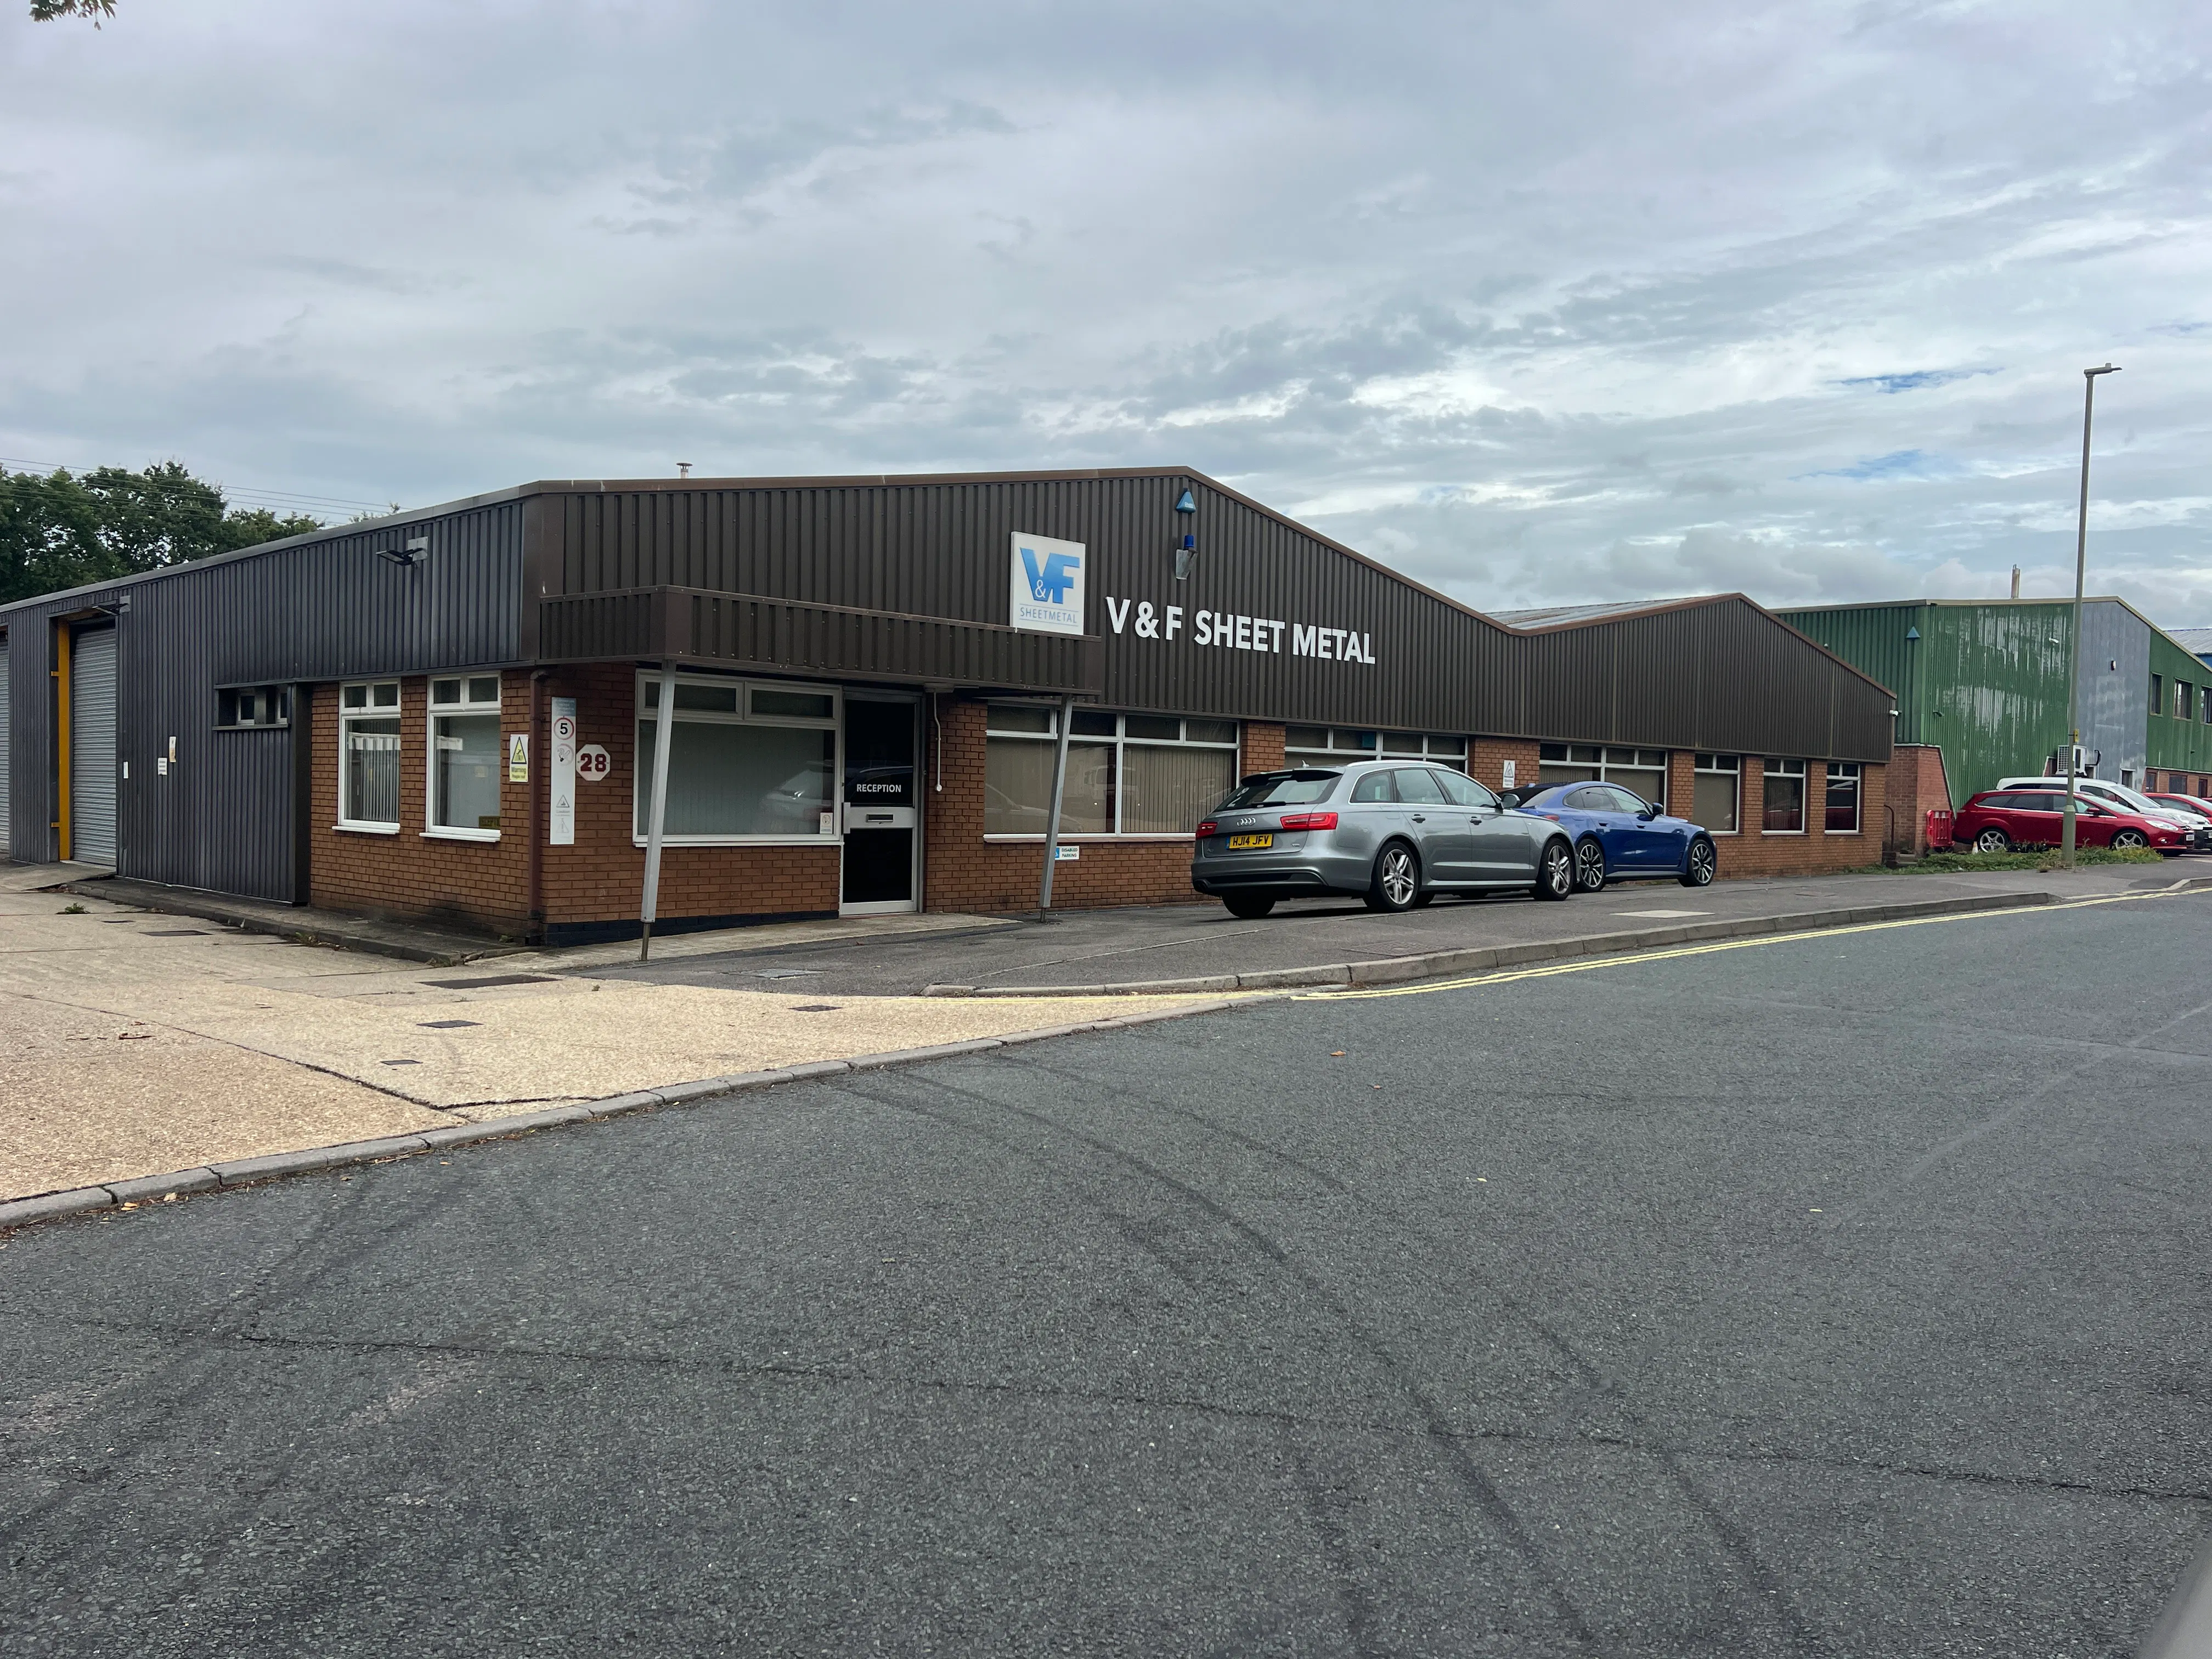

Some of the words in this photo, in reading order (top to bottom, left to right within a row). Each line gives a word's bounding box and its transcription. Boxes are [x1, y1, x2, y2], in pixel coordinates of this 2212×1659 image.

[1020, 607, 1077, 623] SHEETMETAL
[1105, 596, 1131, 634] V
[1135, 601, 1159, 639] &
[1166, 605, 1183, 640] F
[1194, 610, 1285, 653] SHEET
[1293, 623, 1375, 664] METAL
[560, 723, 568, 735] 5
[580, 753, 606, 772] 28
[856, 783, 901, 793] RECEPTION
[1232, 836, 1250, 846] HJ14
[1252, 835, 1269, 845] JFV
